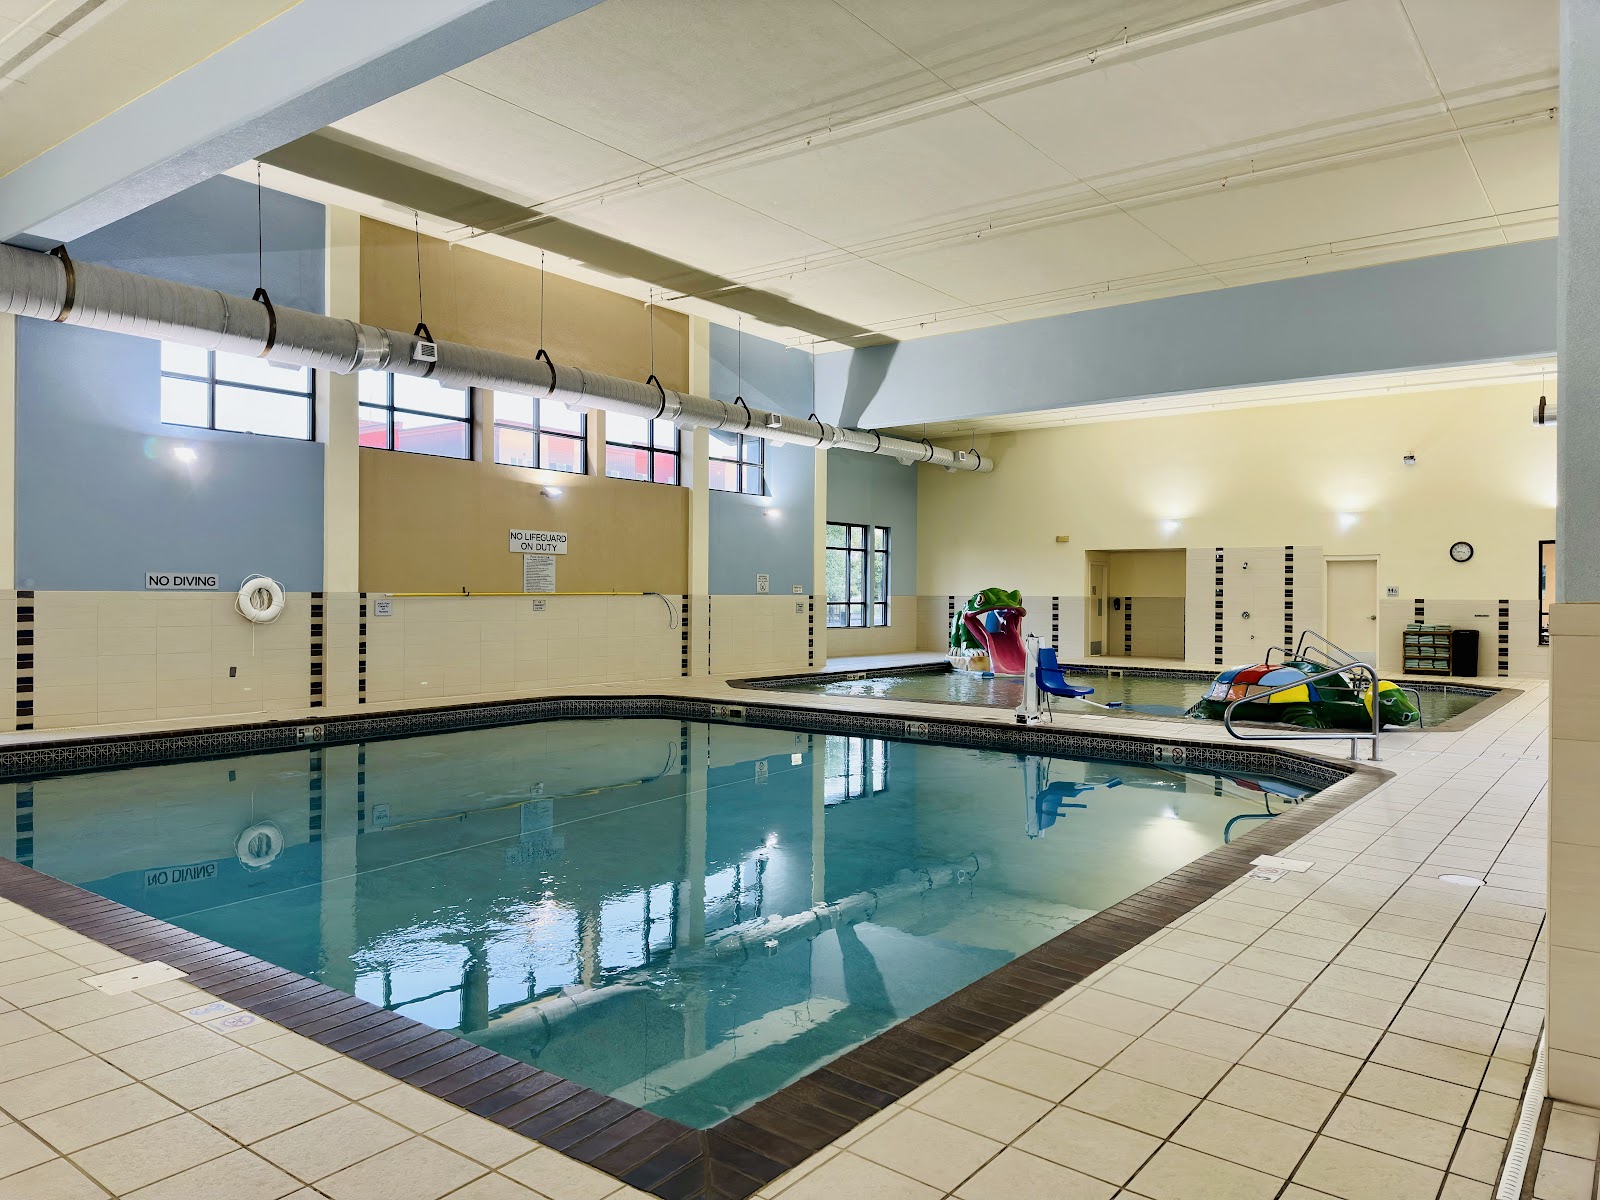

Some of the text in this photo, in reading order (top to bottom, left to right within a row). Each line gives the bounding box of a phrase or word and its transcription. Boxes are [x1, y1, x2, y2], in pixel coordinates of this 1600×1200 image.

[511, 532, 567, 543] NO LIFEGUARD
[520, 542, 557, 551] ON DUTY
[149, 575, 216, 586] NO DIVING
